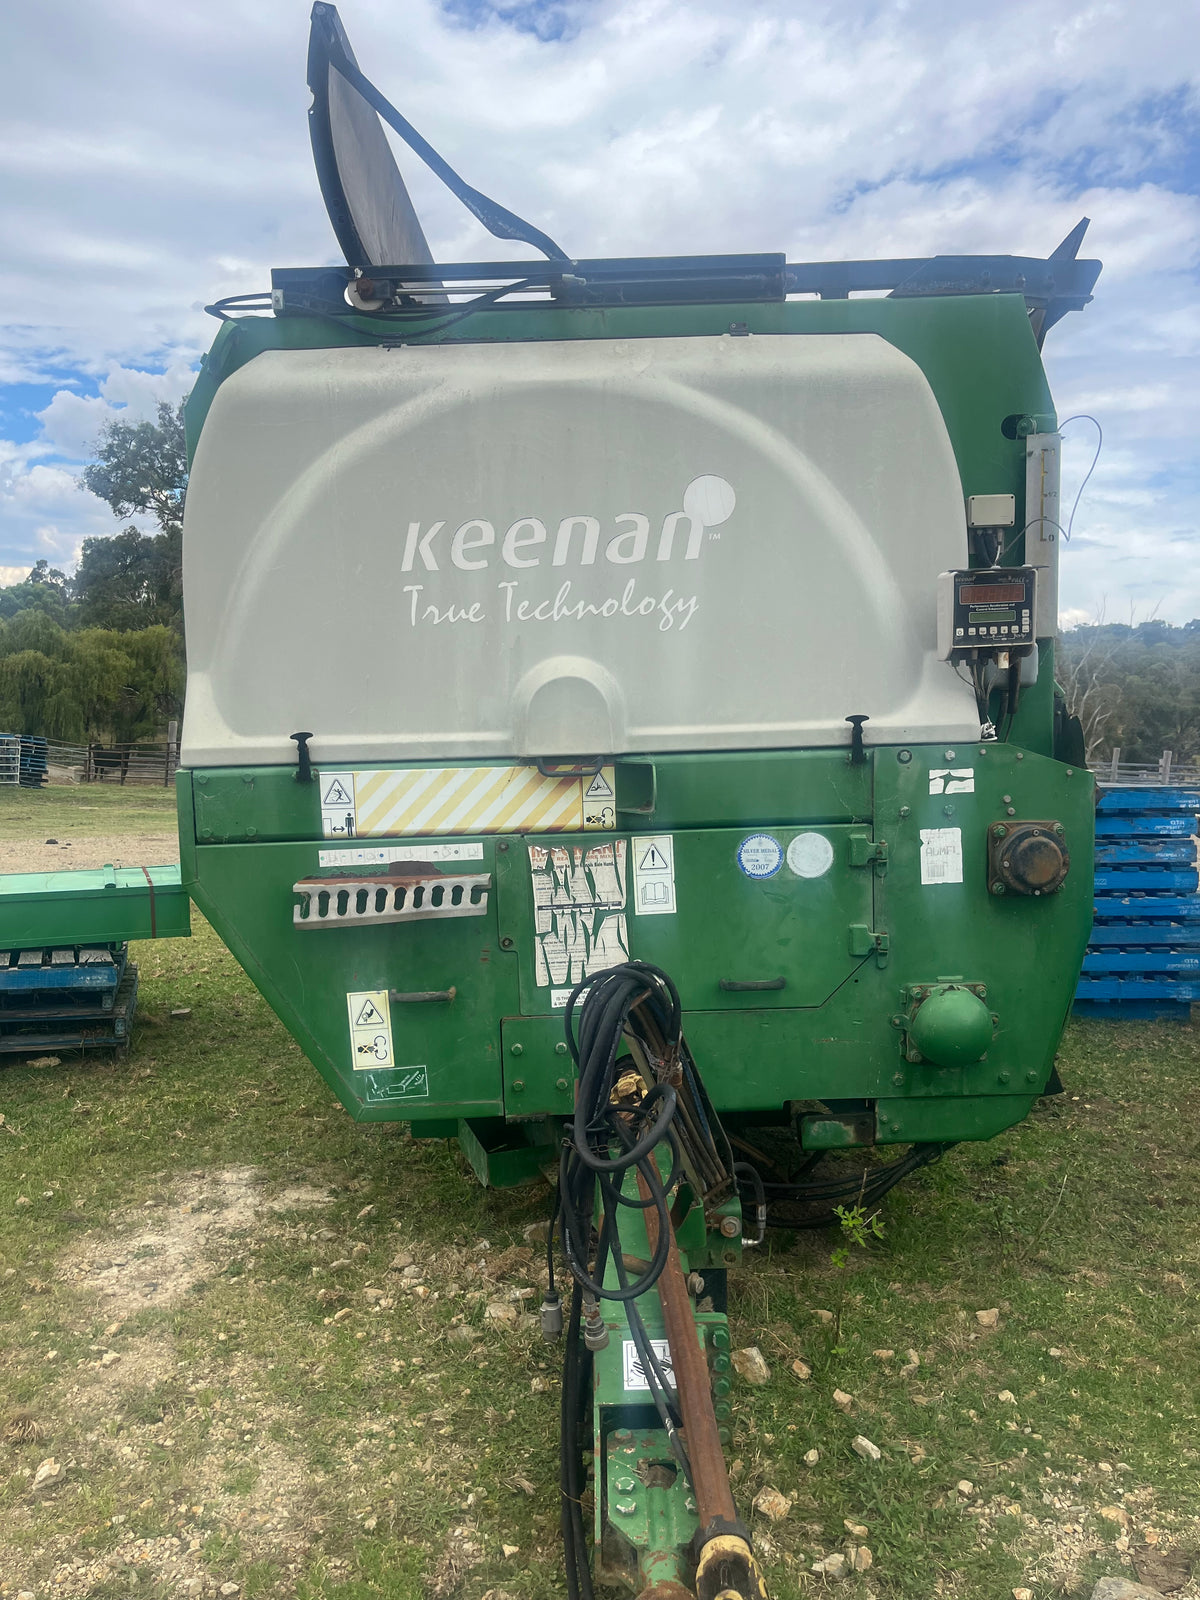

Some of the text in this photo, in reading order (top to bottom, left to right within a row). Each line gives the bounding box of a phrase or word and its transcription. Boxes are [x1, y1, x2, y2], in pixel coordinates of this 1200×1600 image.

[403, 577, 700, 632] True Technology
[750, 863, 770, 871] 2007
